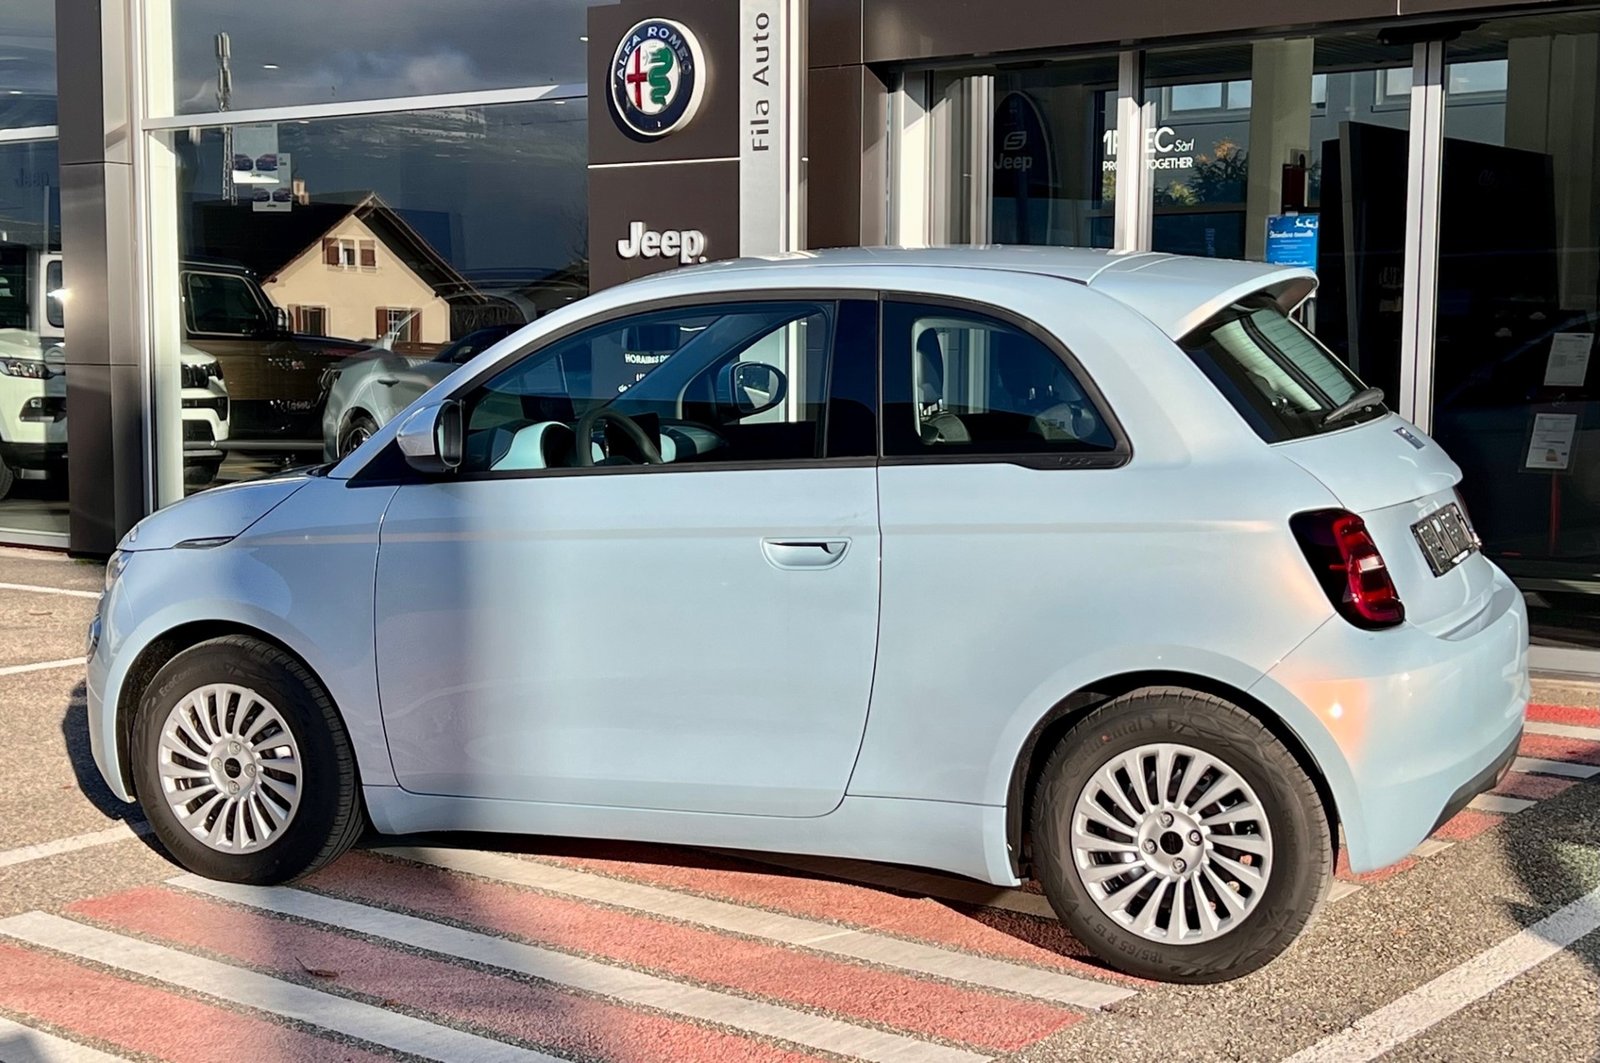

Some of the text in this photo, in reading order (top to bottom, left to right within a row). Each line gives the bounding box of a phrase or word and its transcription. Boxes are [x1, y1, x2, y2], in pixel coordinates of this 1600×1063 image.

[616, 26, 692, 80] ALFA ROMEO
[750, 12, 770, 152] Fila Auto
[994, 153, 1033, 172] Jeep
[1145, 156, 1194, 170] TOGETHER
[617, 221, 705, 263] Jeep
[624, 353, 659, 364] HORAIRES
